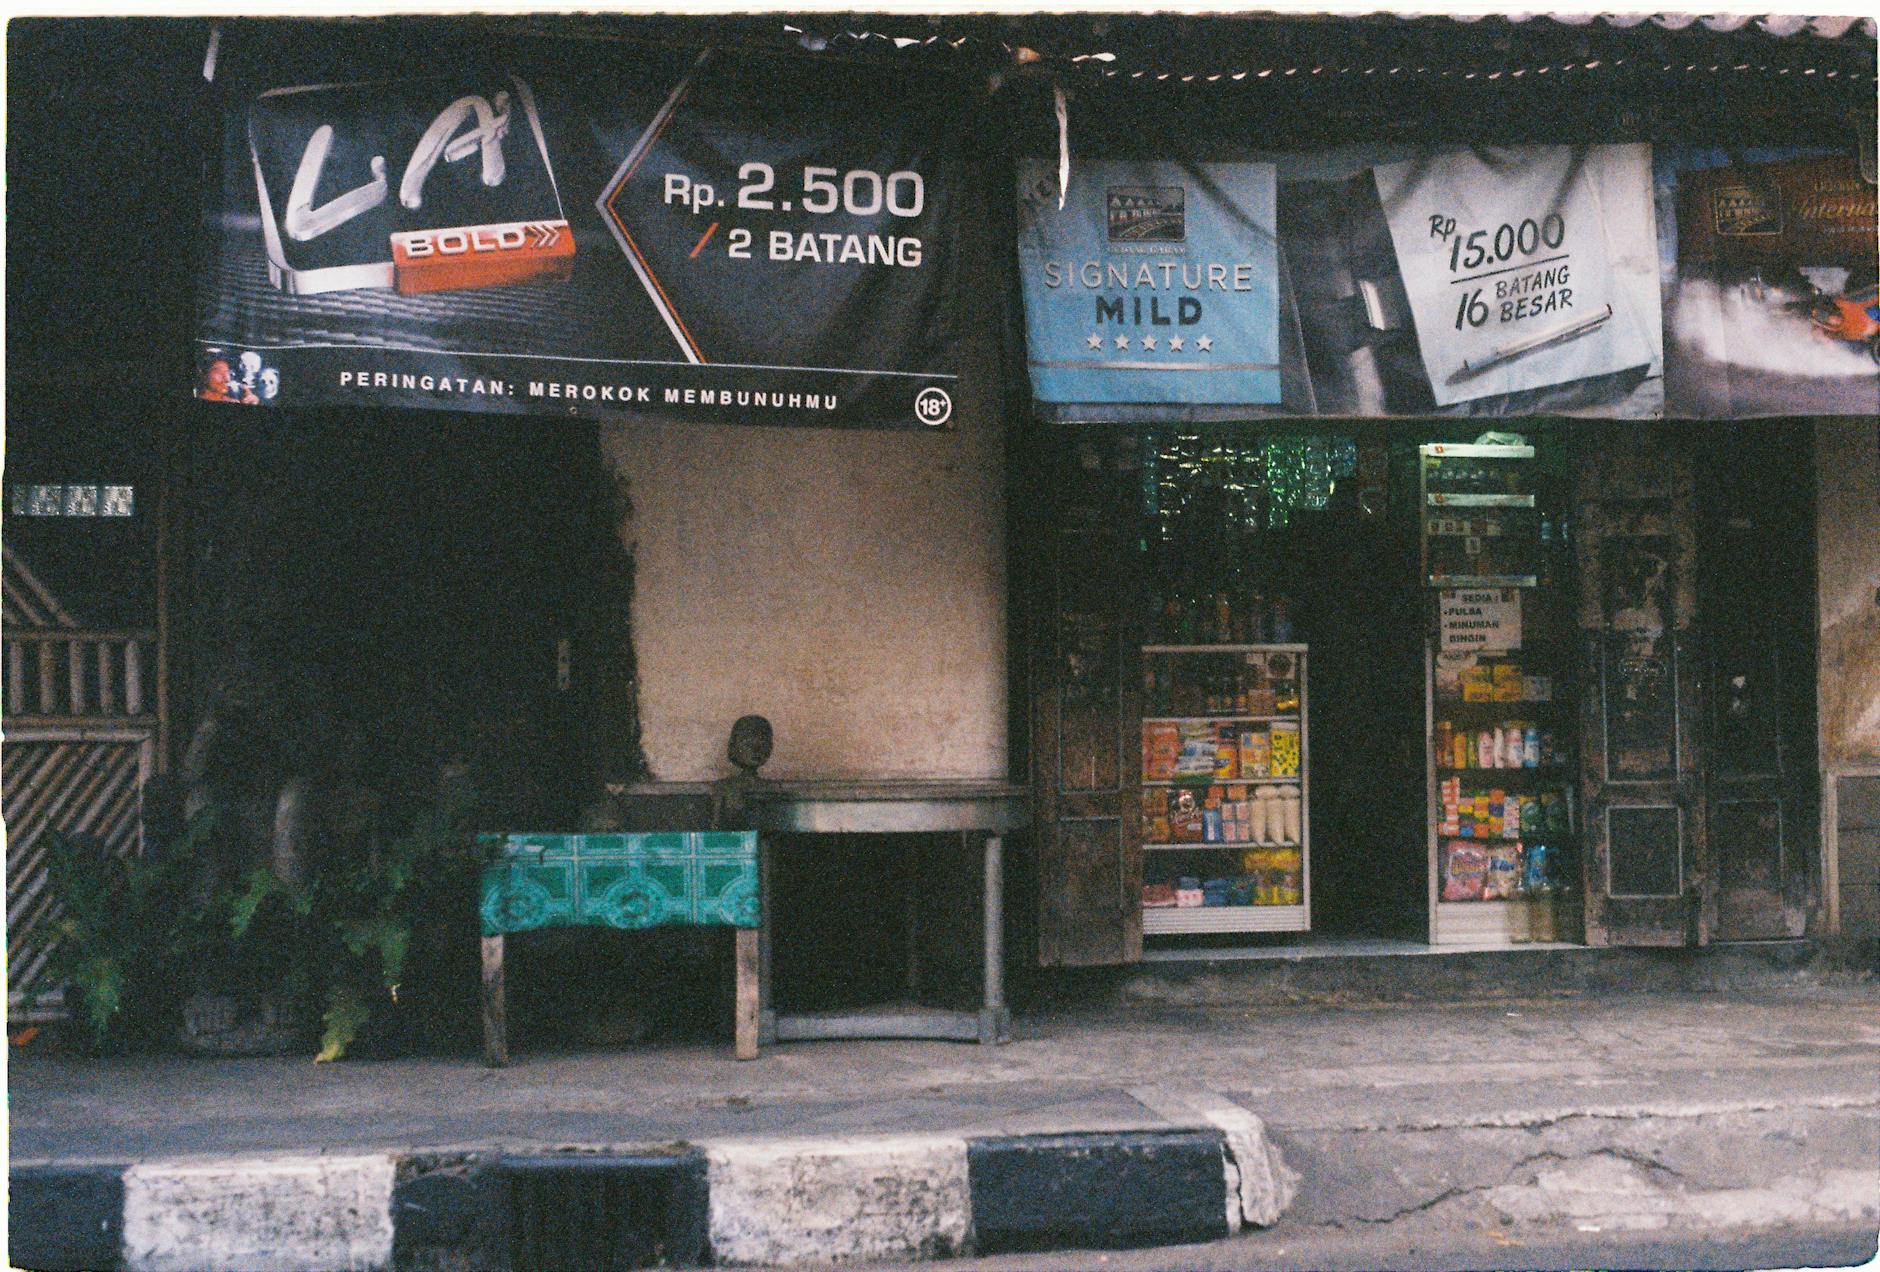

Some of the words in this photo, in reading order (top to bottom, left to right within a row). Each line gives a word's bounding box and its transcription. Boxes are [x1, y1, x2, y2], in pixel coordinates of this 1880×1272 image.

[663, 172, 725, 215] Rp.
[737, 161, 925, 218] 2.500
[404, 226, 526, 258] BOLD
[727, 228, 752, 259] 2
[768, 230, 923, 268] BATANG
[1428, 214, 1457, 242] Rp
[1449, 213, 1565, 273] 15.000
[1043, 260, 1253, 293] SIGNATURE
[1094, 295, 1203, 326] MILD
[1455, 288, 1489, 331] 16
[1495, 265, 1571, 299] BATANG
[1500, 288, 1573, 324] BESAR
[339, 371, 515, 396] PERINGATAN:
[529, 381, 651, 402] MEROKOK
[664, 388, 838, 410] MEMBUNUHMU
[919, 398, 948, 417] 18+
[1448, 620, 1500, 630] MINUMAN
